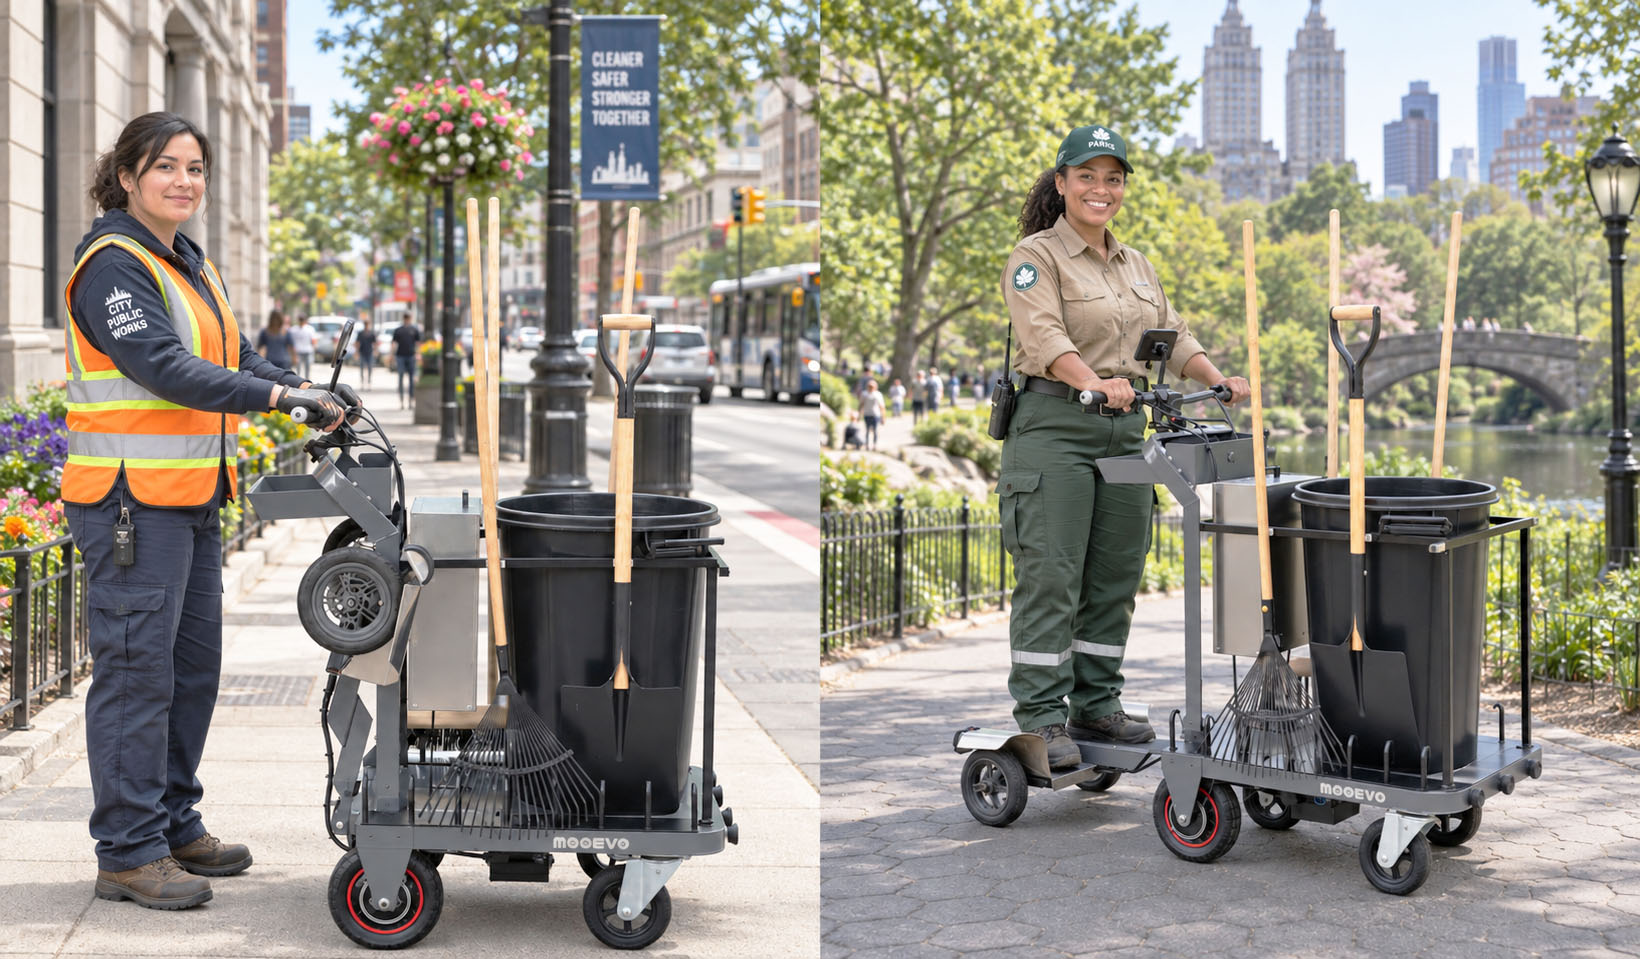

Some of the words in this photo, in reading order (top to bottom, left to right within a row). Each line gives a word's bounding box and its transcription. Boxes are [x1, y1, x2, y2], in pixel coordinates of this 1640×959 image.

[592, 51, 644, 68] CLEANER
[592, 71, 629, 87] SAFER
[592, 90, 650, 106] STRONGER
[592, 110, 650, 126] TOGETHER
[108, 299, 132, 315] CITY
[107, 308, 144, 330] PUBLIC
[111, 319, 148, 341] WORKS
[1320, 782, 1386, 803] MOOEVO
[553, 836, 630, 850] MOOEVO
